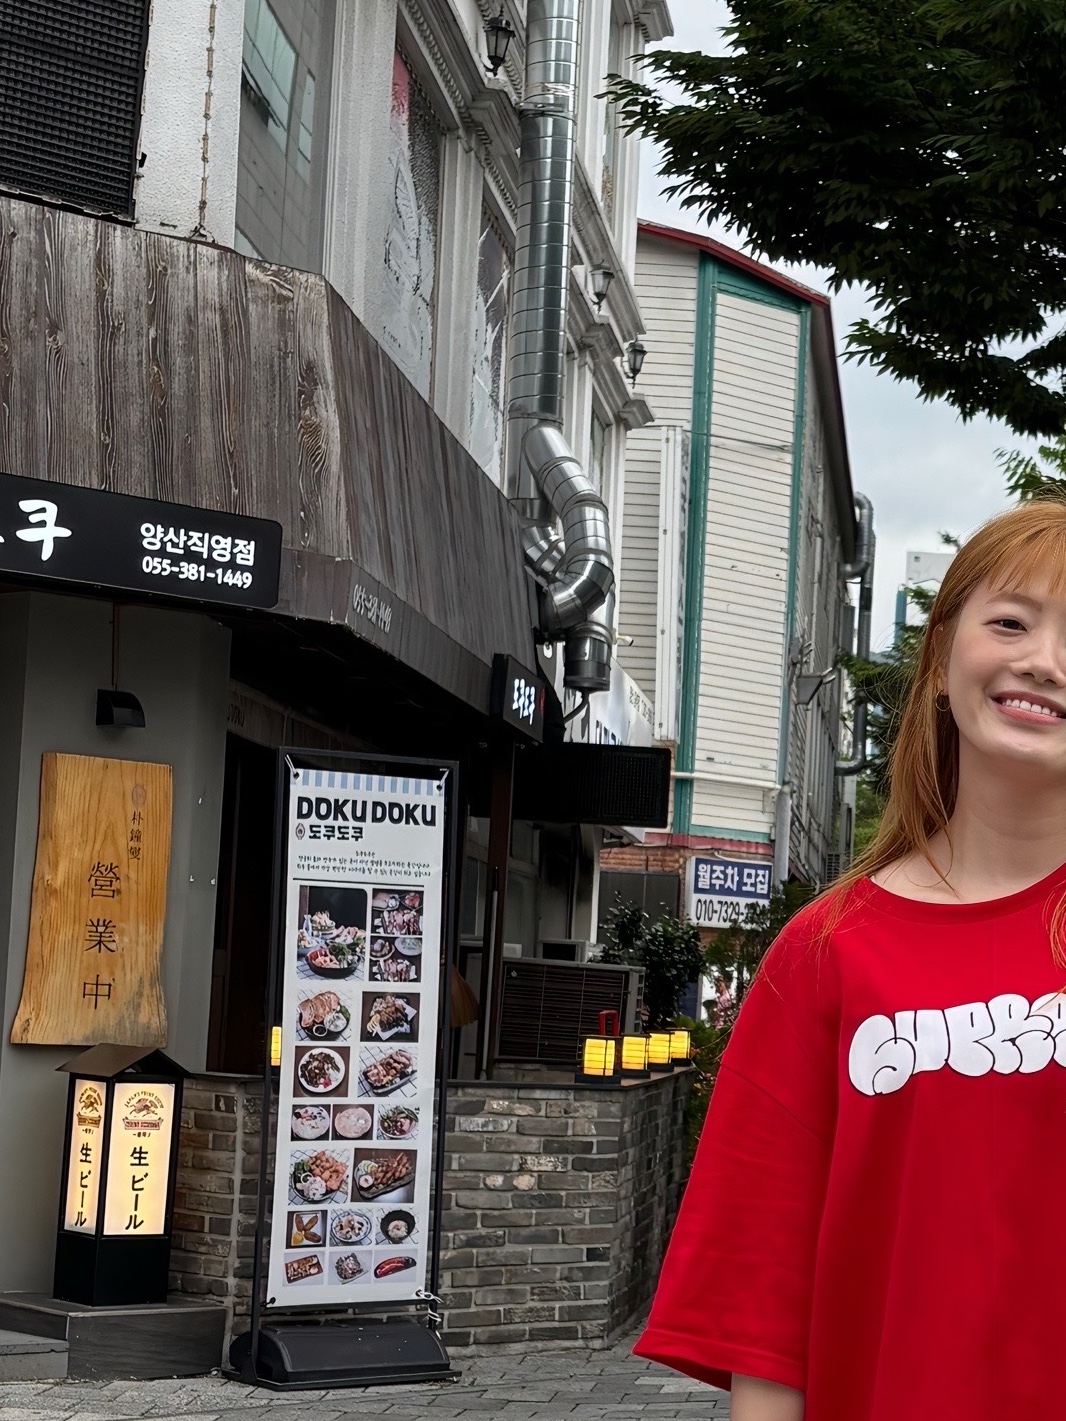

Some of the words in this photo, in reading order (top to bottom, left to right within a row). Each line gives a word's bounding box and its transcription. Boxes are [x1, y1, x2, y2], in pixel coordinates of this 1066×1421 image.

[0, 500, 72, 561] 쿠
[140, 522, 256, 566] 양산직영점
[142, 555, 253, 590] 055-381-1449
[297, 796, 367, 823] DOKU
[371, 801, 436, 827] DOKU
[309, 824, 364, 842] 도쿠도쿠
[697, 863, 740, 892] 월주차
[742, 868, 769, 894] 모집
[83, 861, 121, 1010] 營業中
[75, 1142, 92, 1227] 生ビール
[125, 1146, 149, 1230] 生ビール
